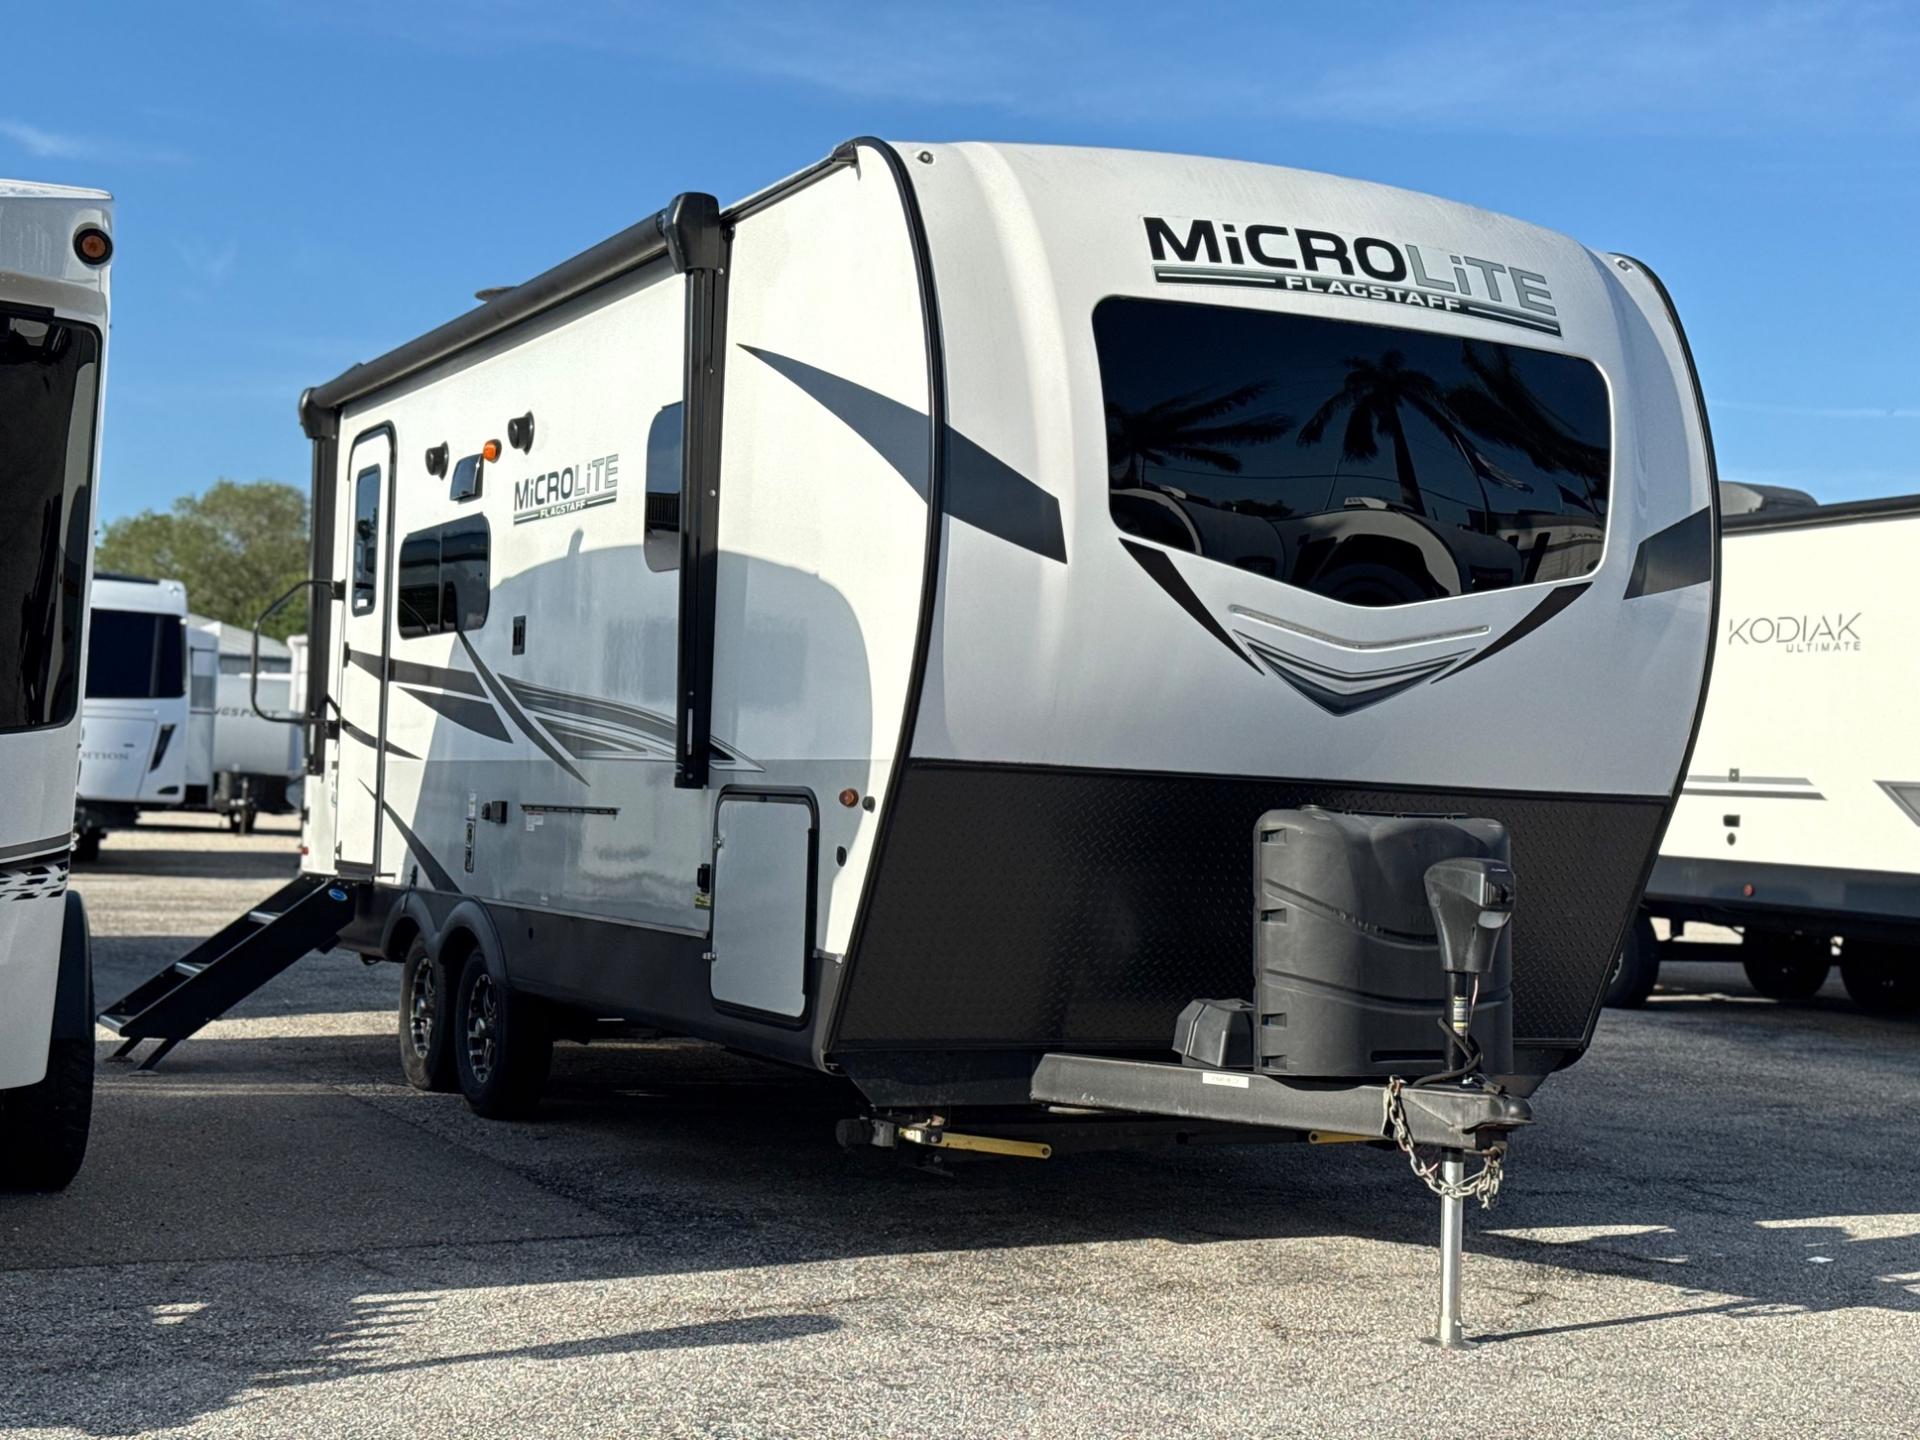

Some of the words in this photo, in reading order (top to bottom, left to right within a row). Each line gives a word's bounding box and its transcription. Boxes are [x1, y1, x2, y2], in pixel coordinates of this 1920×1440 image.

[1285, 275, 1461, 313] FLAGSTAFF
[540, 499, 586, 518] FLAGSTAFF
[1728, 612, 1862, 645] KODIAK
[1786, 641, 1861, 653] ULTIMATE
